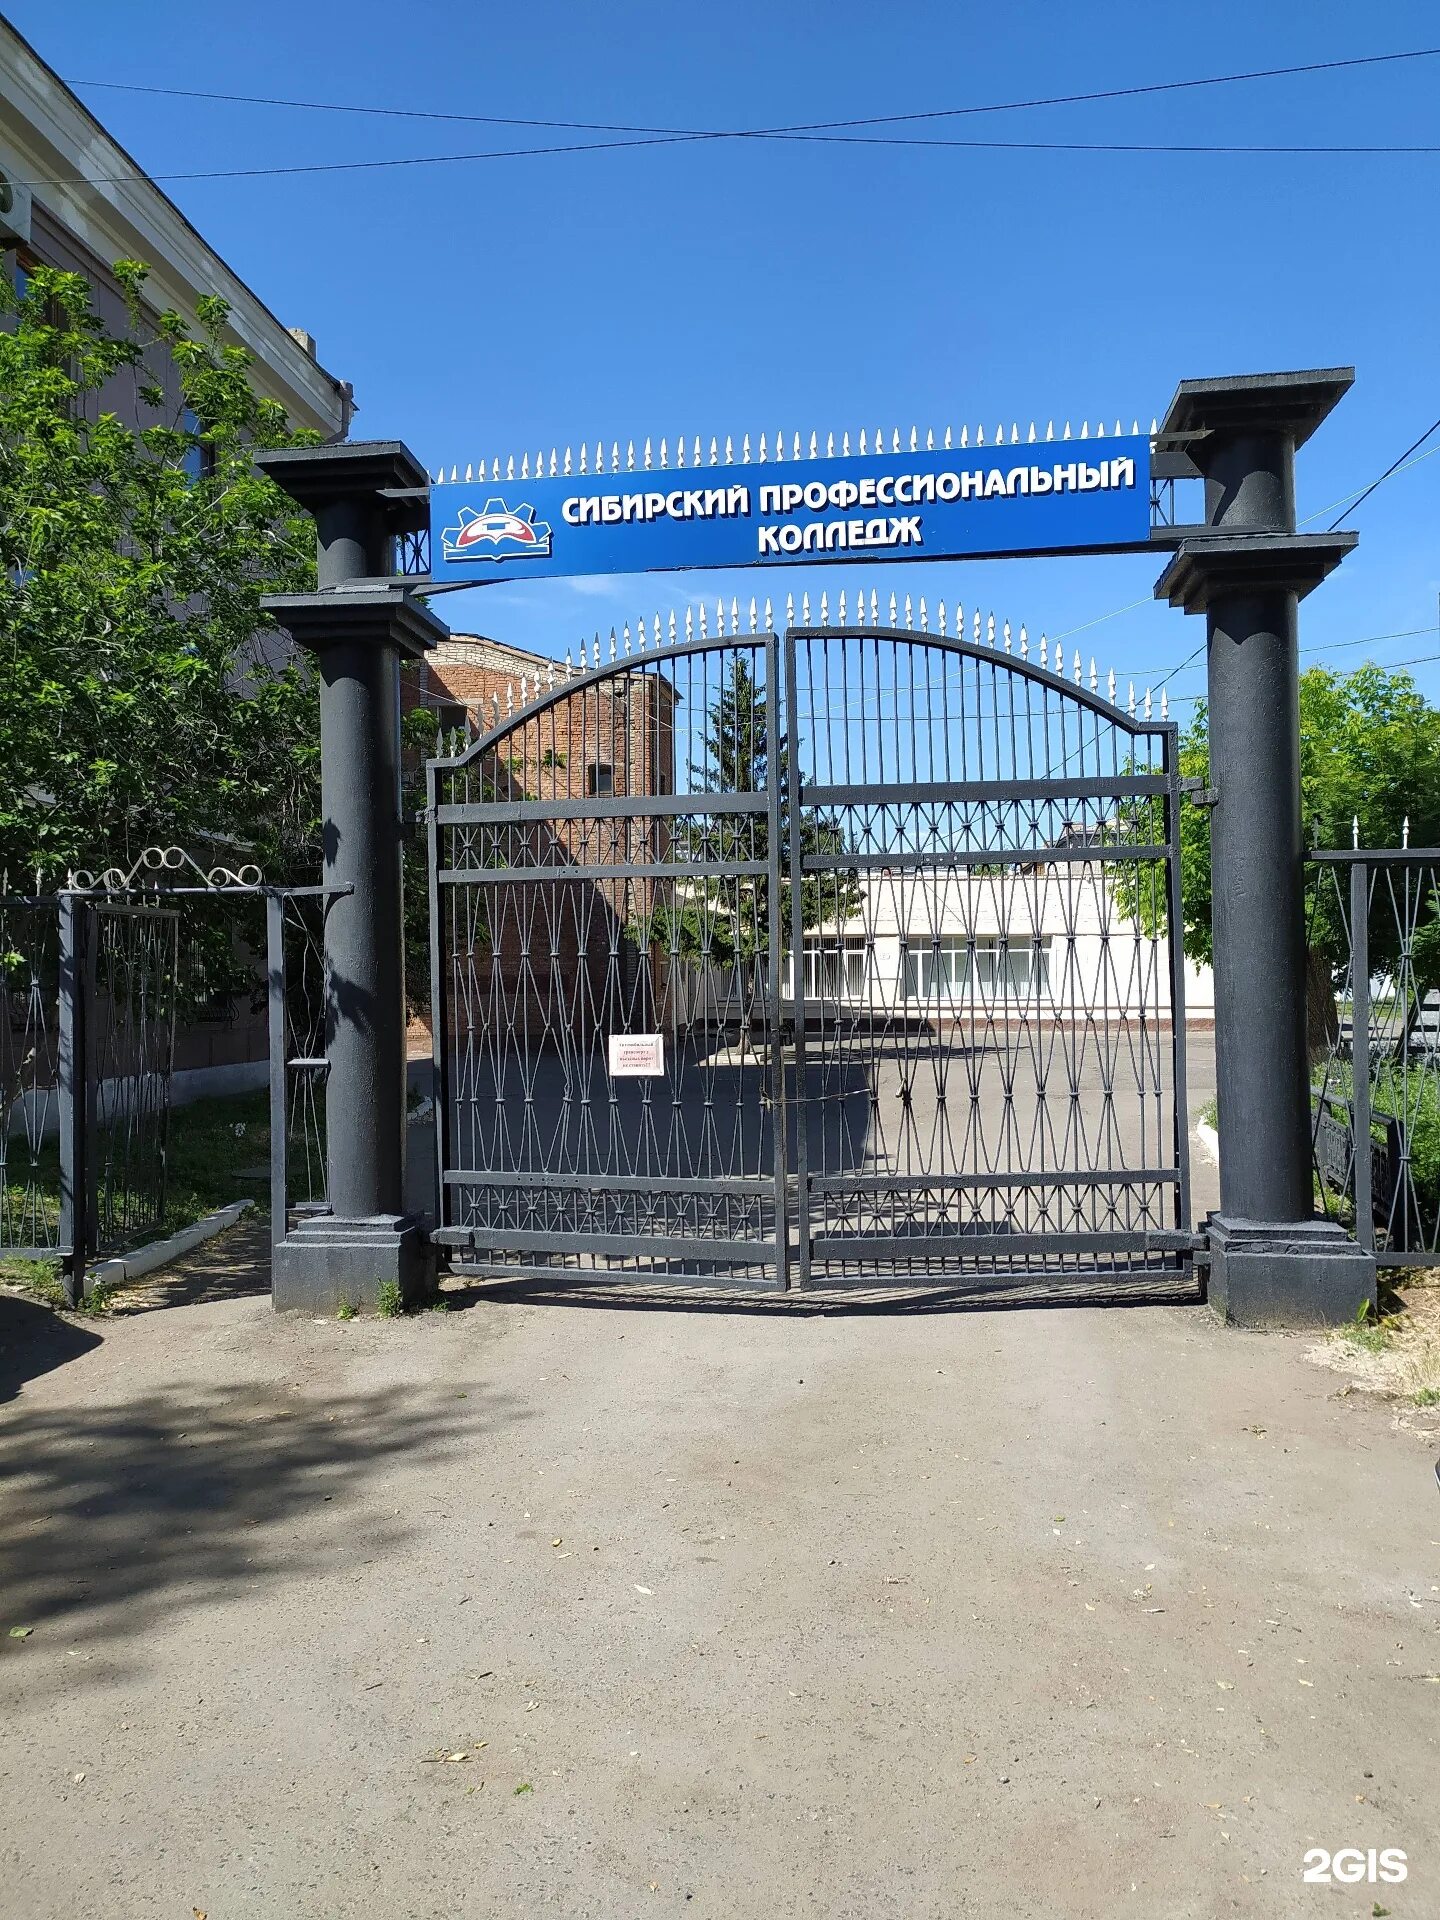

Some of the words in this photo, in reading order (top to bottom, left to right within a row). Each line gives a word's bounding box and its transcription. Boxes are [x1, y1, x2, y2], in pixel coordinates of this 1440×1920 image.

[561, 484, 750, 525] СИБИРСКИЙ
[759, 456, 1135, 513] ПРОФЕССИОНАЛЬНЫЙ
[758, 516, 922, 554] КОЛЛЕДЖ
